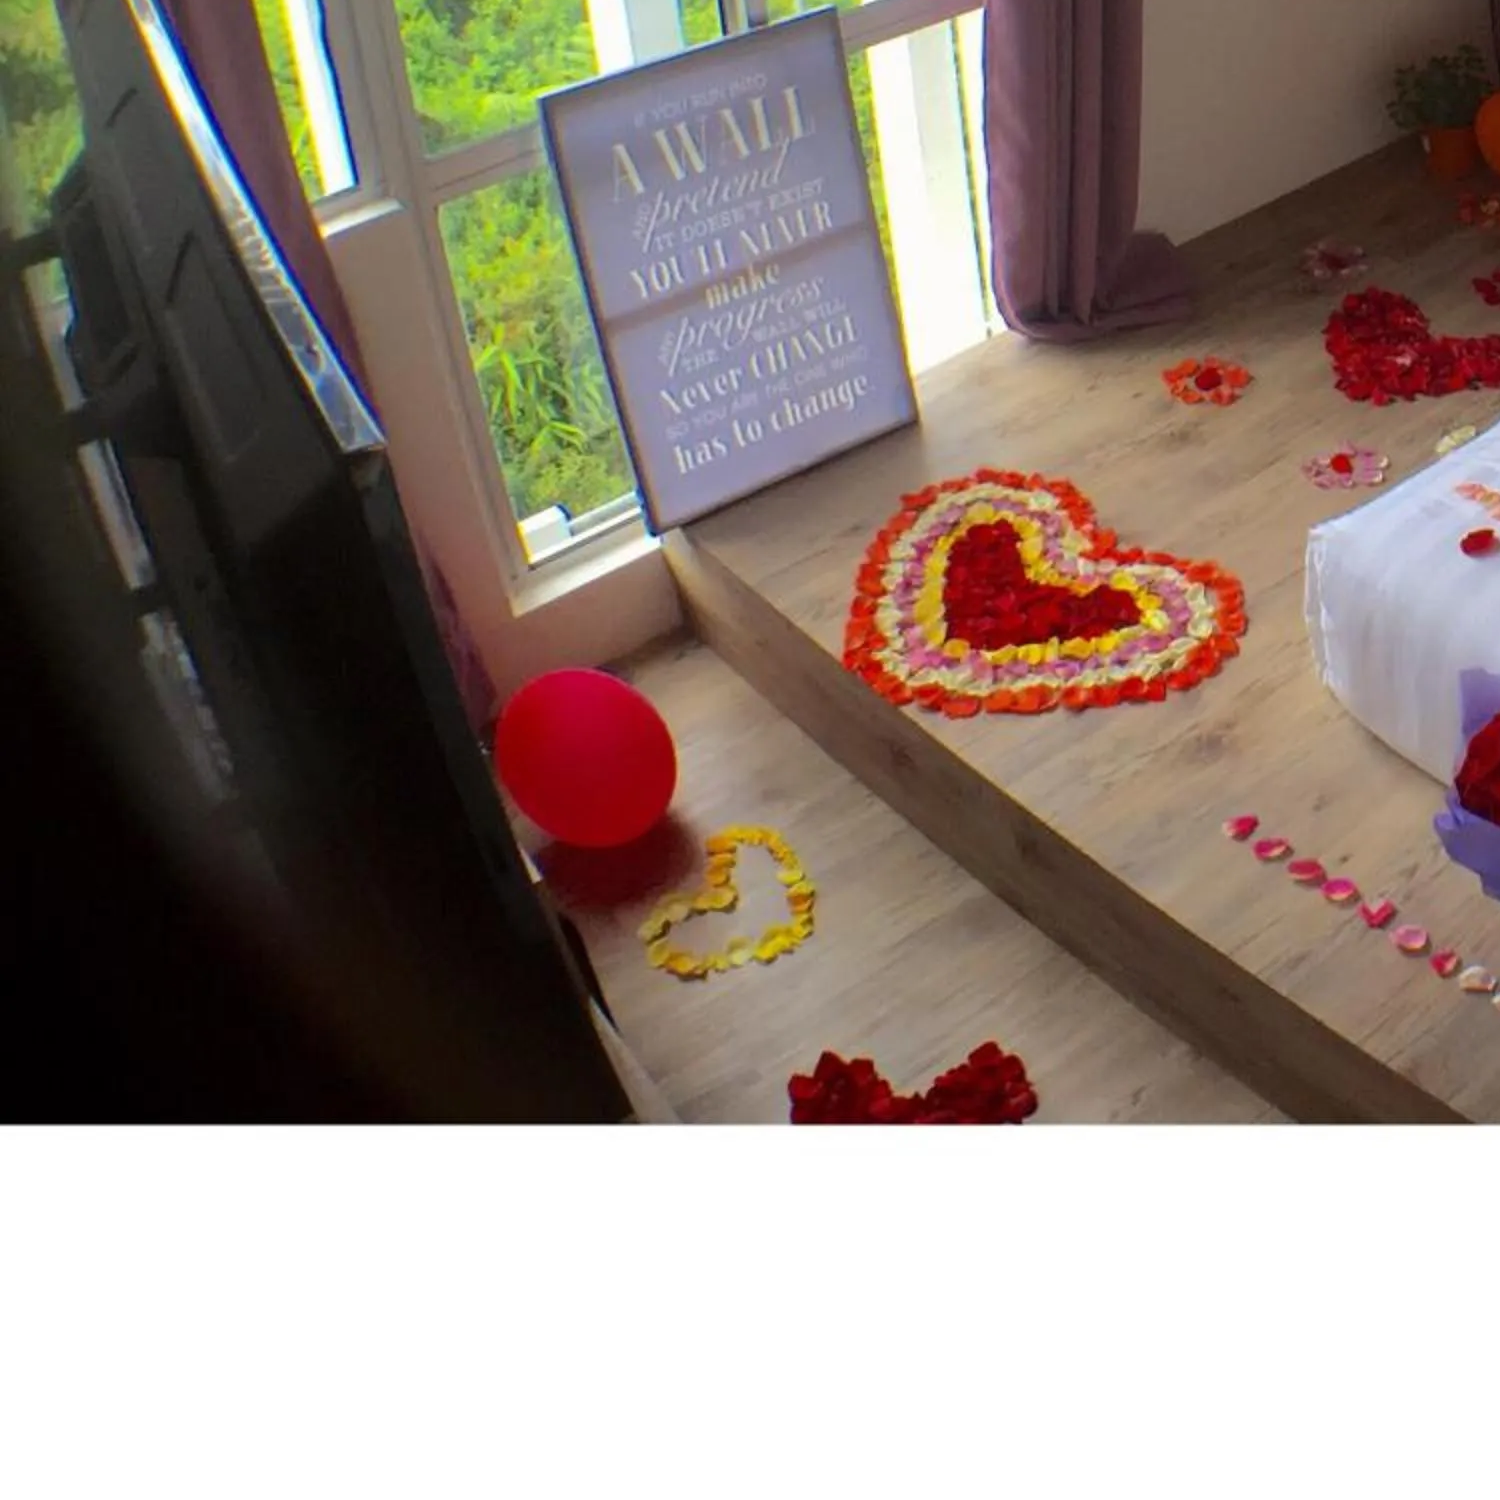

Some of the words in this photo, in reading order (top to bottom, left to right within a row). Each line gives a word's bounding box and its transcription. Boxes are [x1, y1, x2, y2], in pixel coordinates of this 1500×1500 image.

[651, 97, 689, 123] YOU
[610, 141, 647, 204] A
[651, 83, 816, 182] WALL
[642, 135, 789, 254] pretend
[765, 176, 825, 211] EXIST
[738, 197, 835, 260] NEVER
[703, 261, 783, 310] make
[669, 274, 823, 378] progress
[659, 362, 744, 414] Never
[746, 311, 859, 382] CHANGE
[672, 426, 728, 475] has
[730, 409, 765, 450] to
